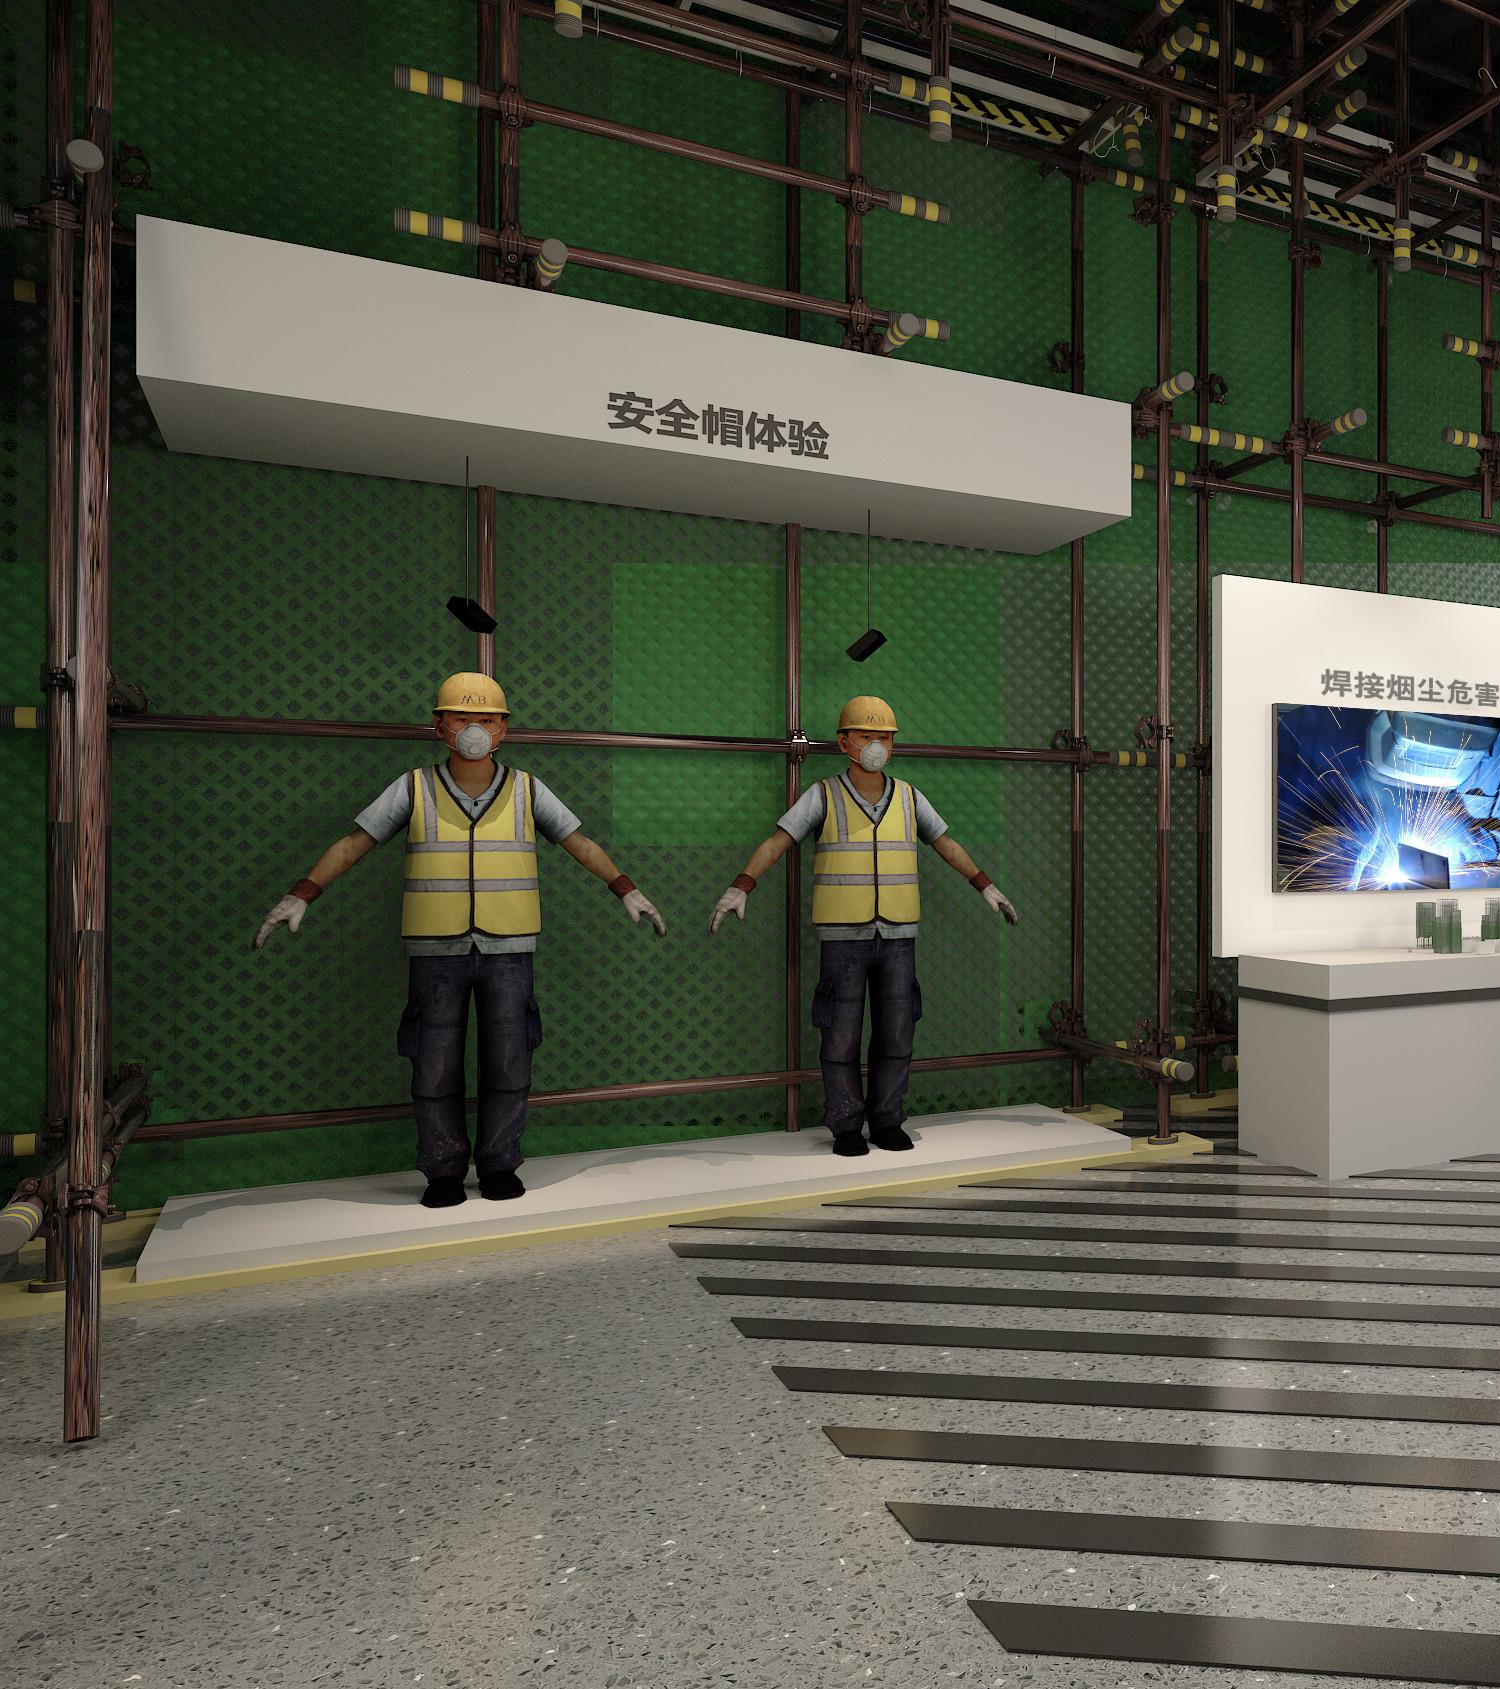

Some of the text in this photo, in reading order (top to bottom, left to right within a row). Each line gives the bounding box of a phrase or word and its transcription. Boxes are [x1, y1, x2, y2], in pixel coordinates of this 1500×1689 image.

[607, 391, 830, 460] 安全帽体验
[1320, 668, 1500, 708] 焊接烟尘危害
